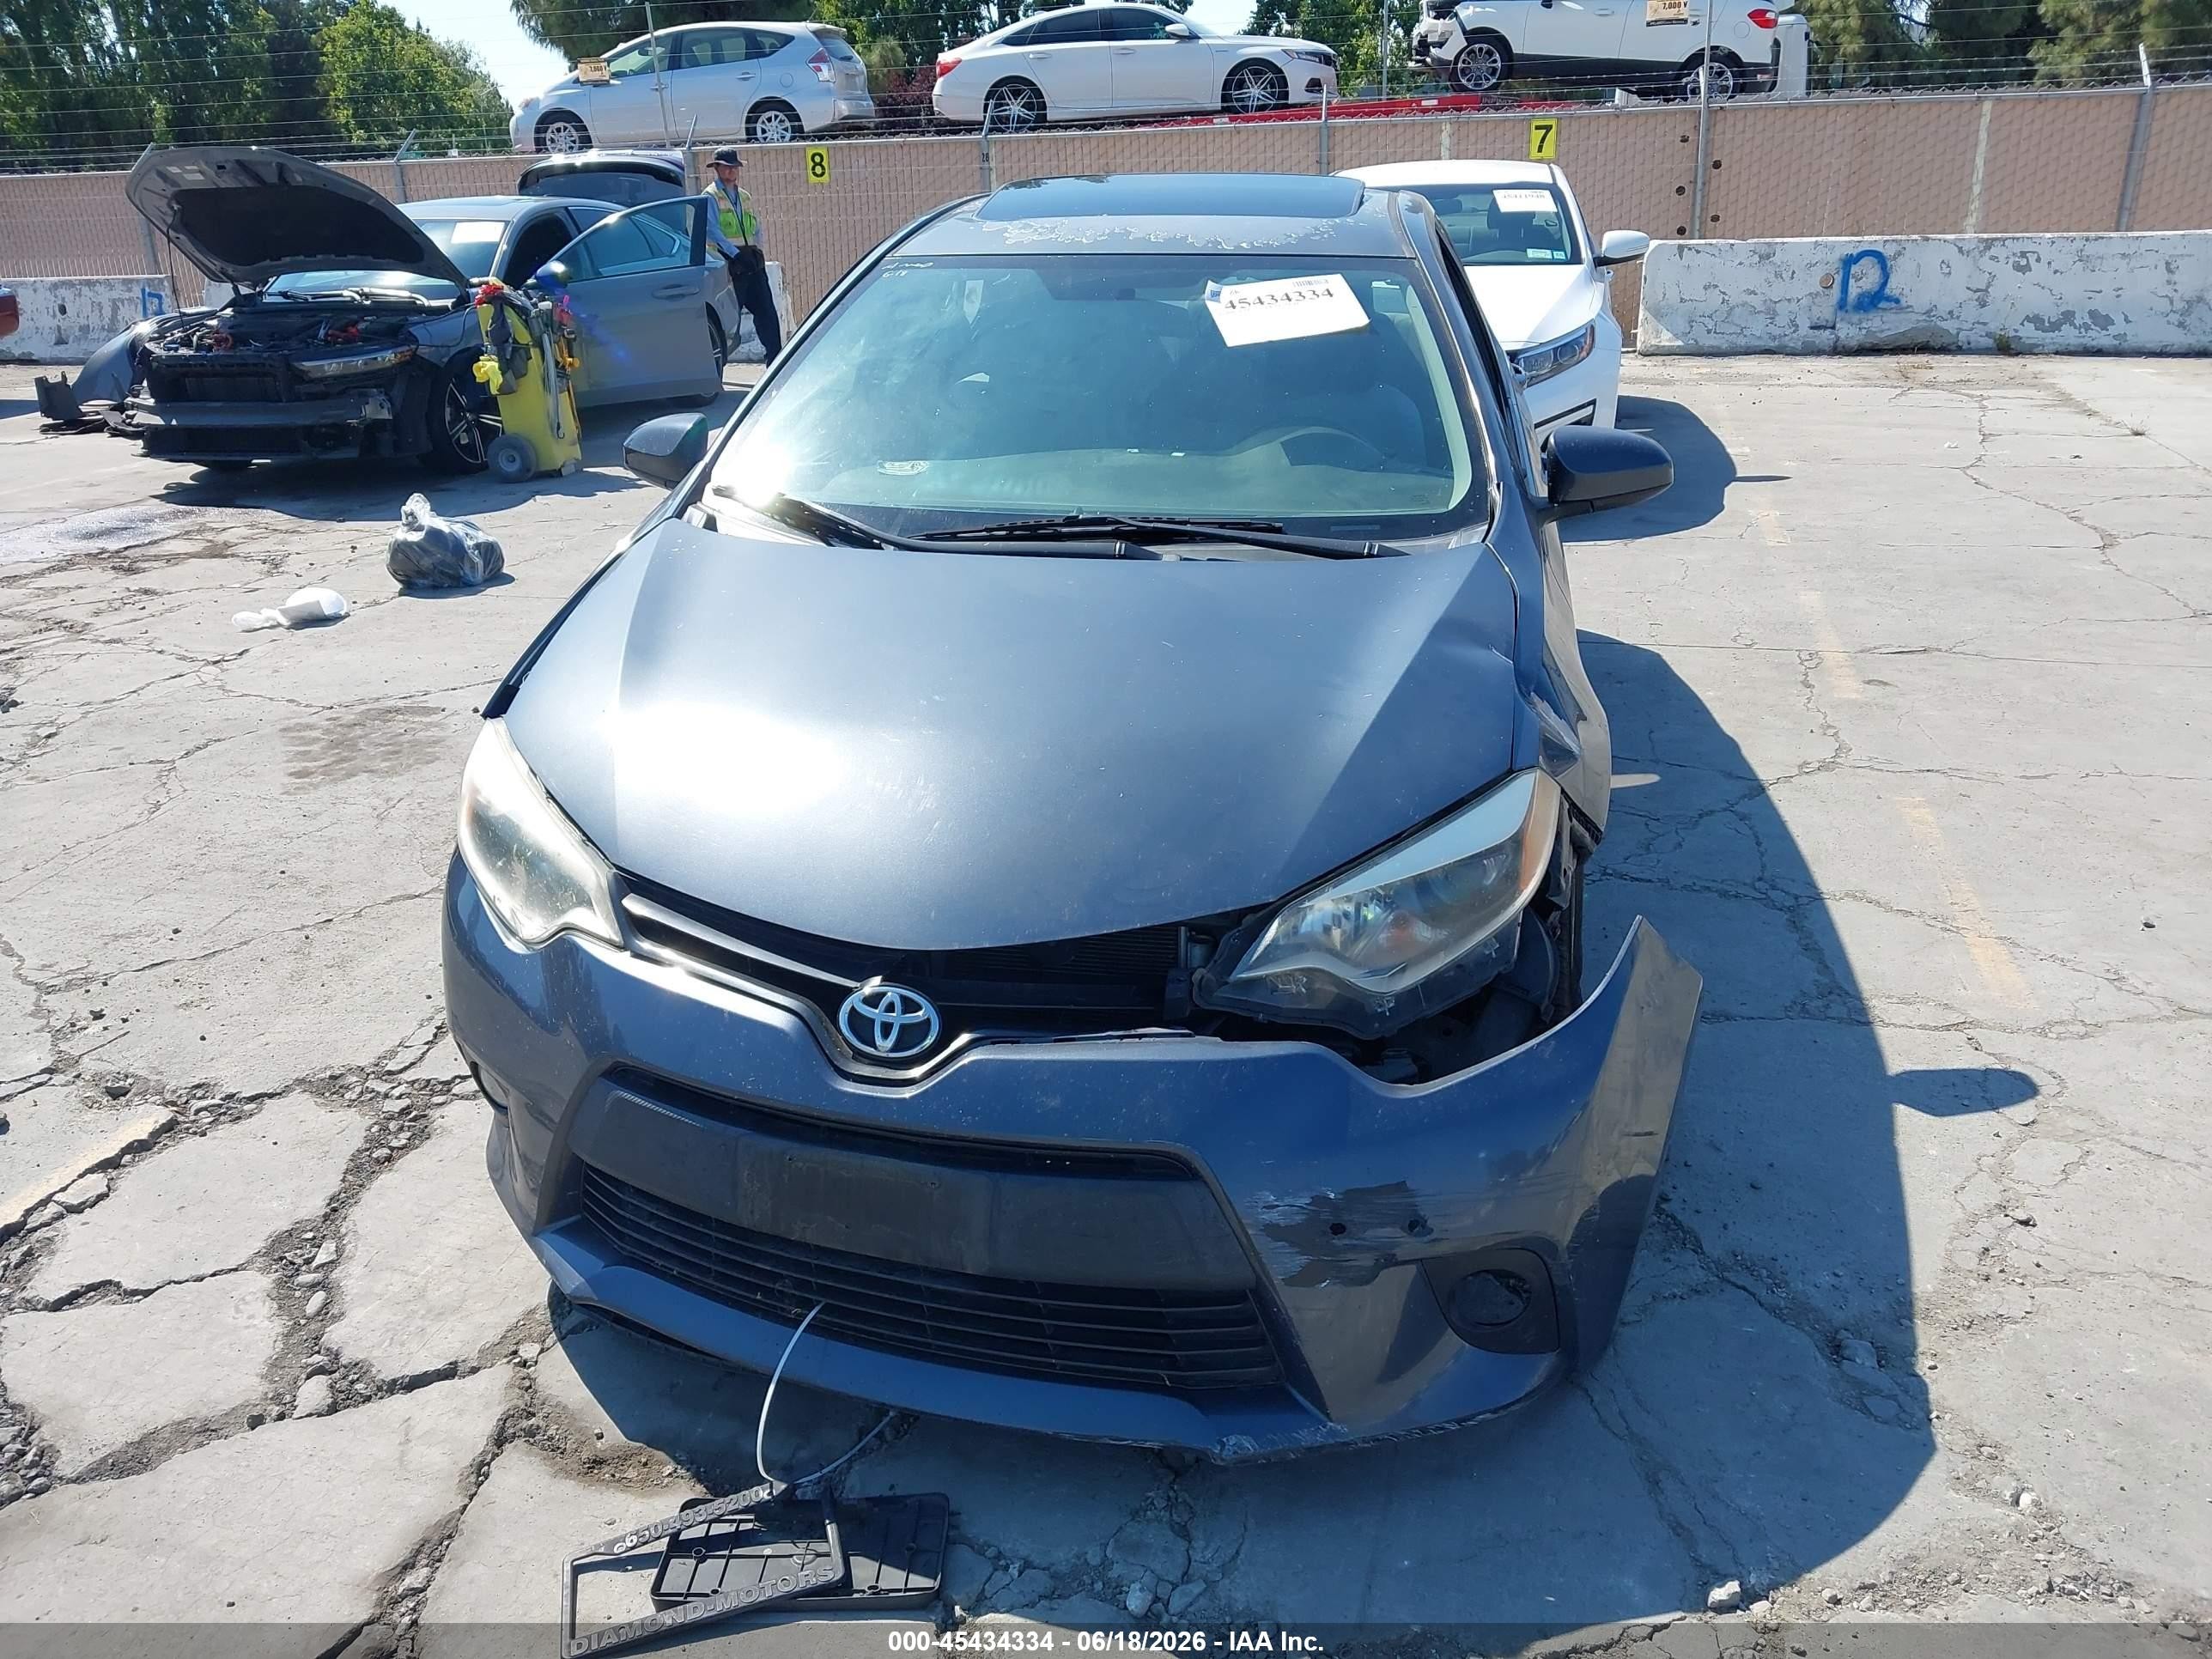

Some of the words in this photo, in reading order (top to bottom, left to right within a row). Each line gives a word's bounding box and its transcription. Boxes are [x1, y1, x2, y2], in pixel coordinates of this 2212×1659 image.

[1534, 124, 1553, 154] 7
[810, 151, 826, 178] 8
[1224, 288, 1334, 310] 45434334
